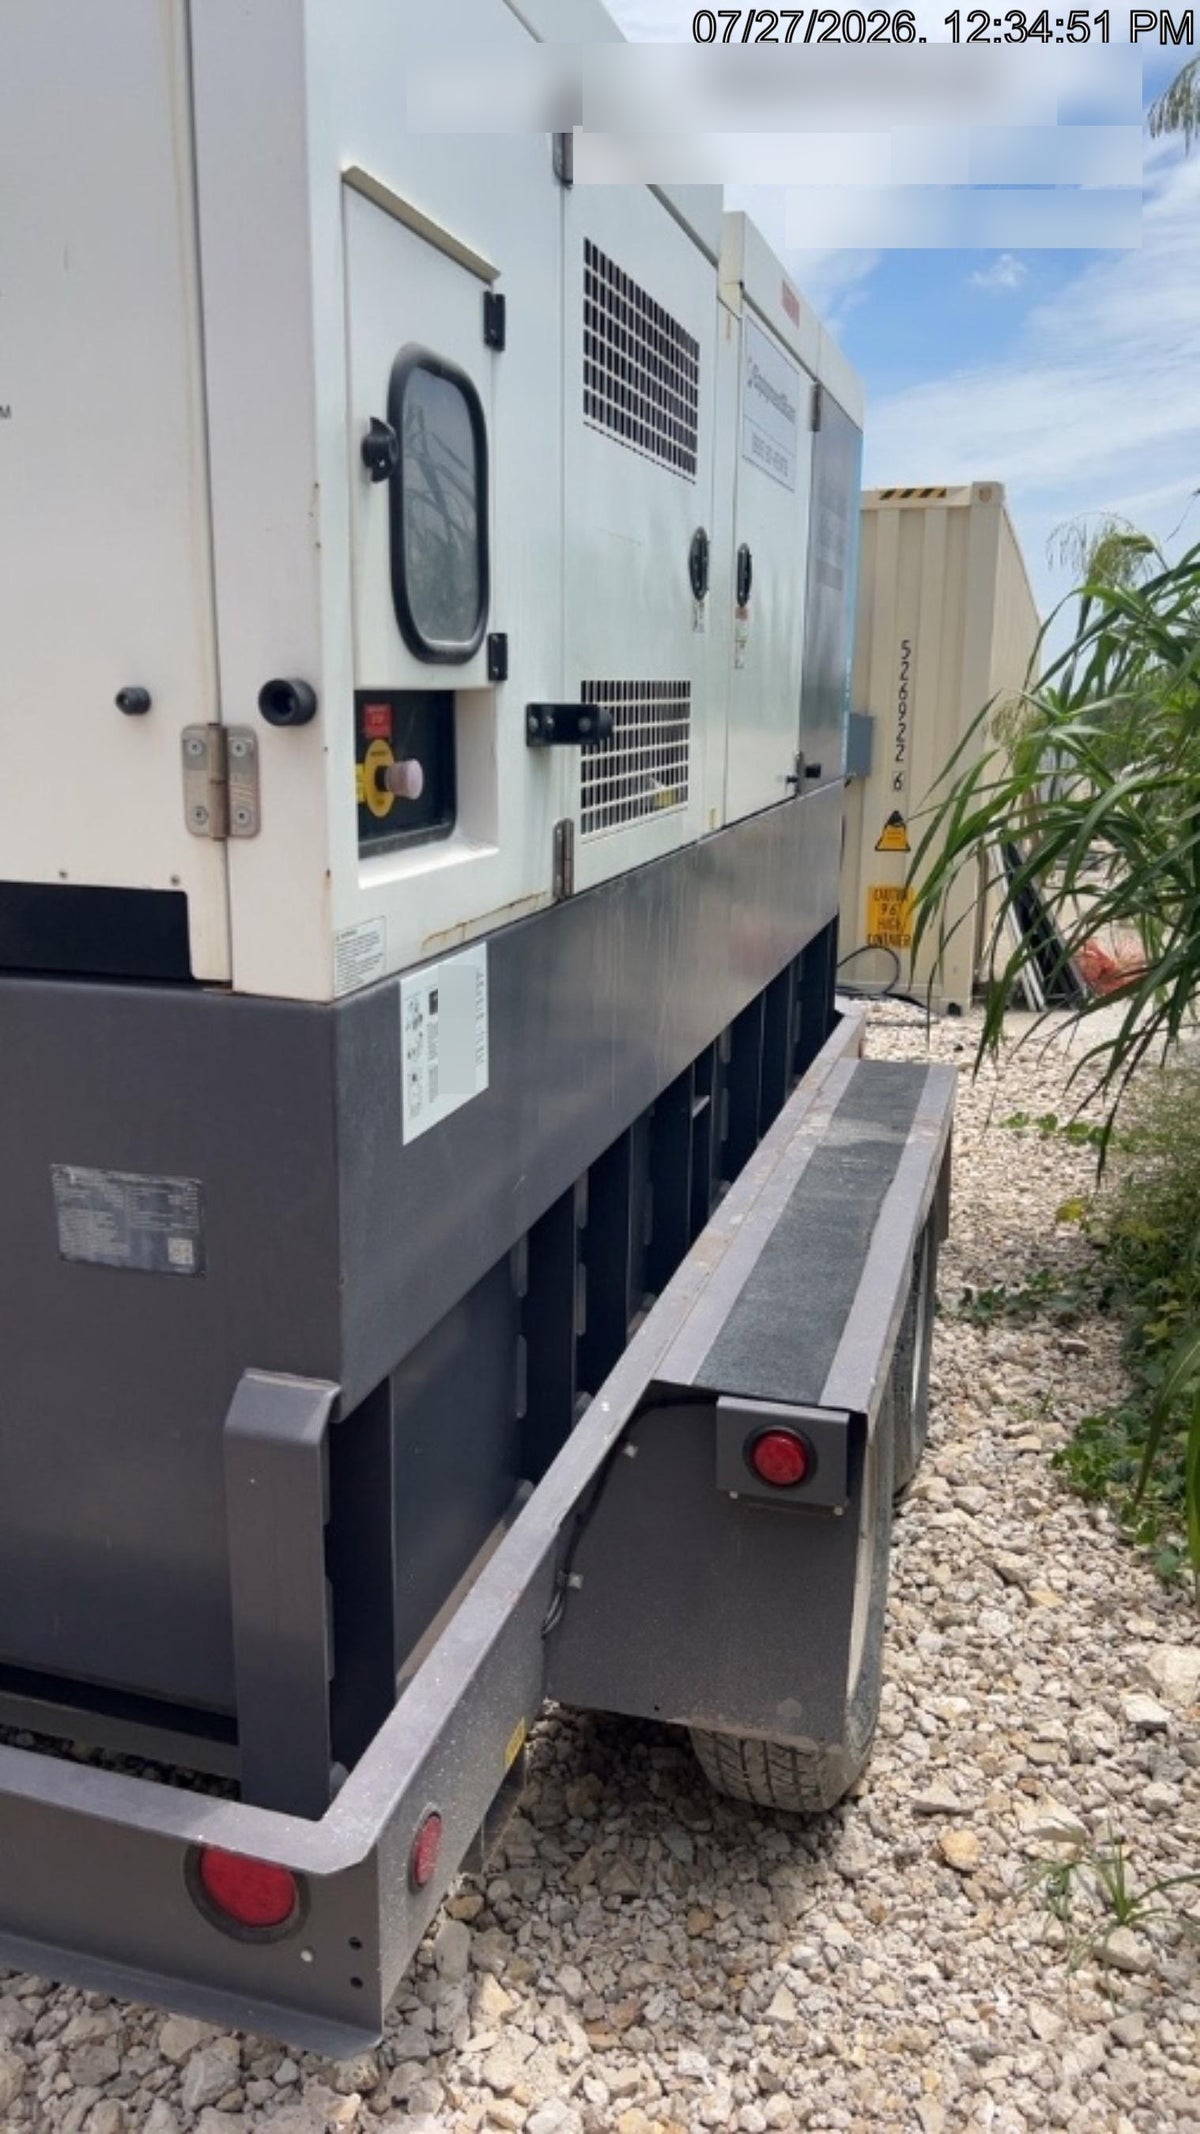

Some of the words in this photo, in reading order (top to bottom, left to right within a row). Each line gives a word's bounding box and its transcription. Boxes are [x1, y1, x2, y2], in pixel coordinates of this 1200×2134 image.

[895, 639, 911, 762] 526922
[893, 772, 903, 791] 6
[874, 888, 905, 902] CAUTIO
